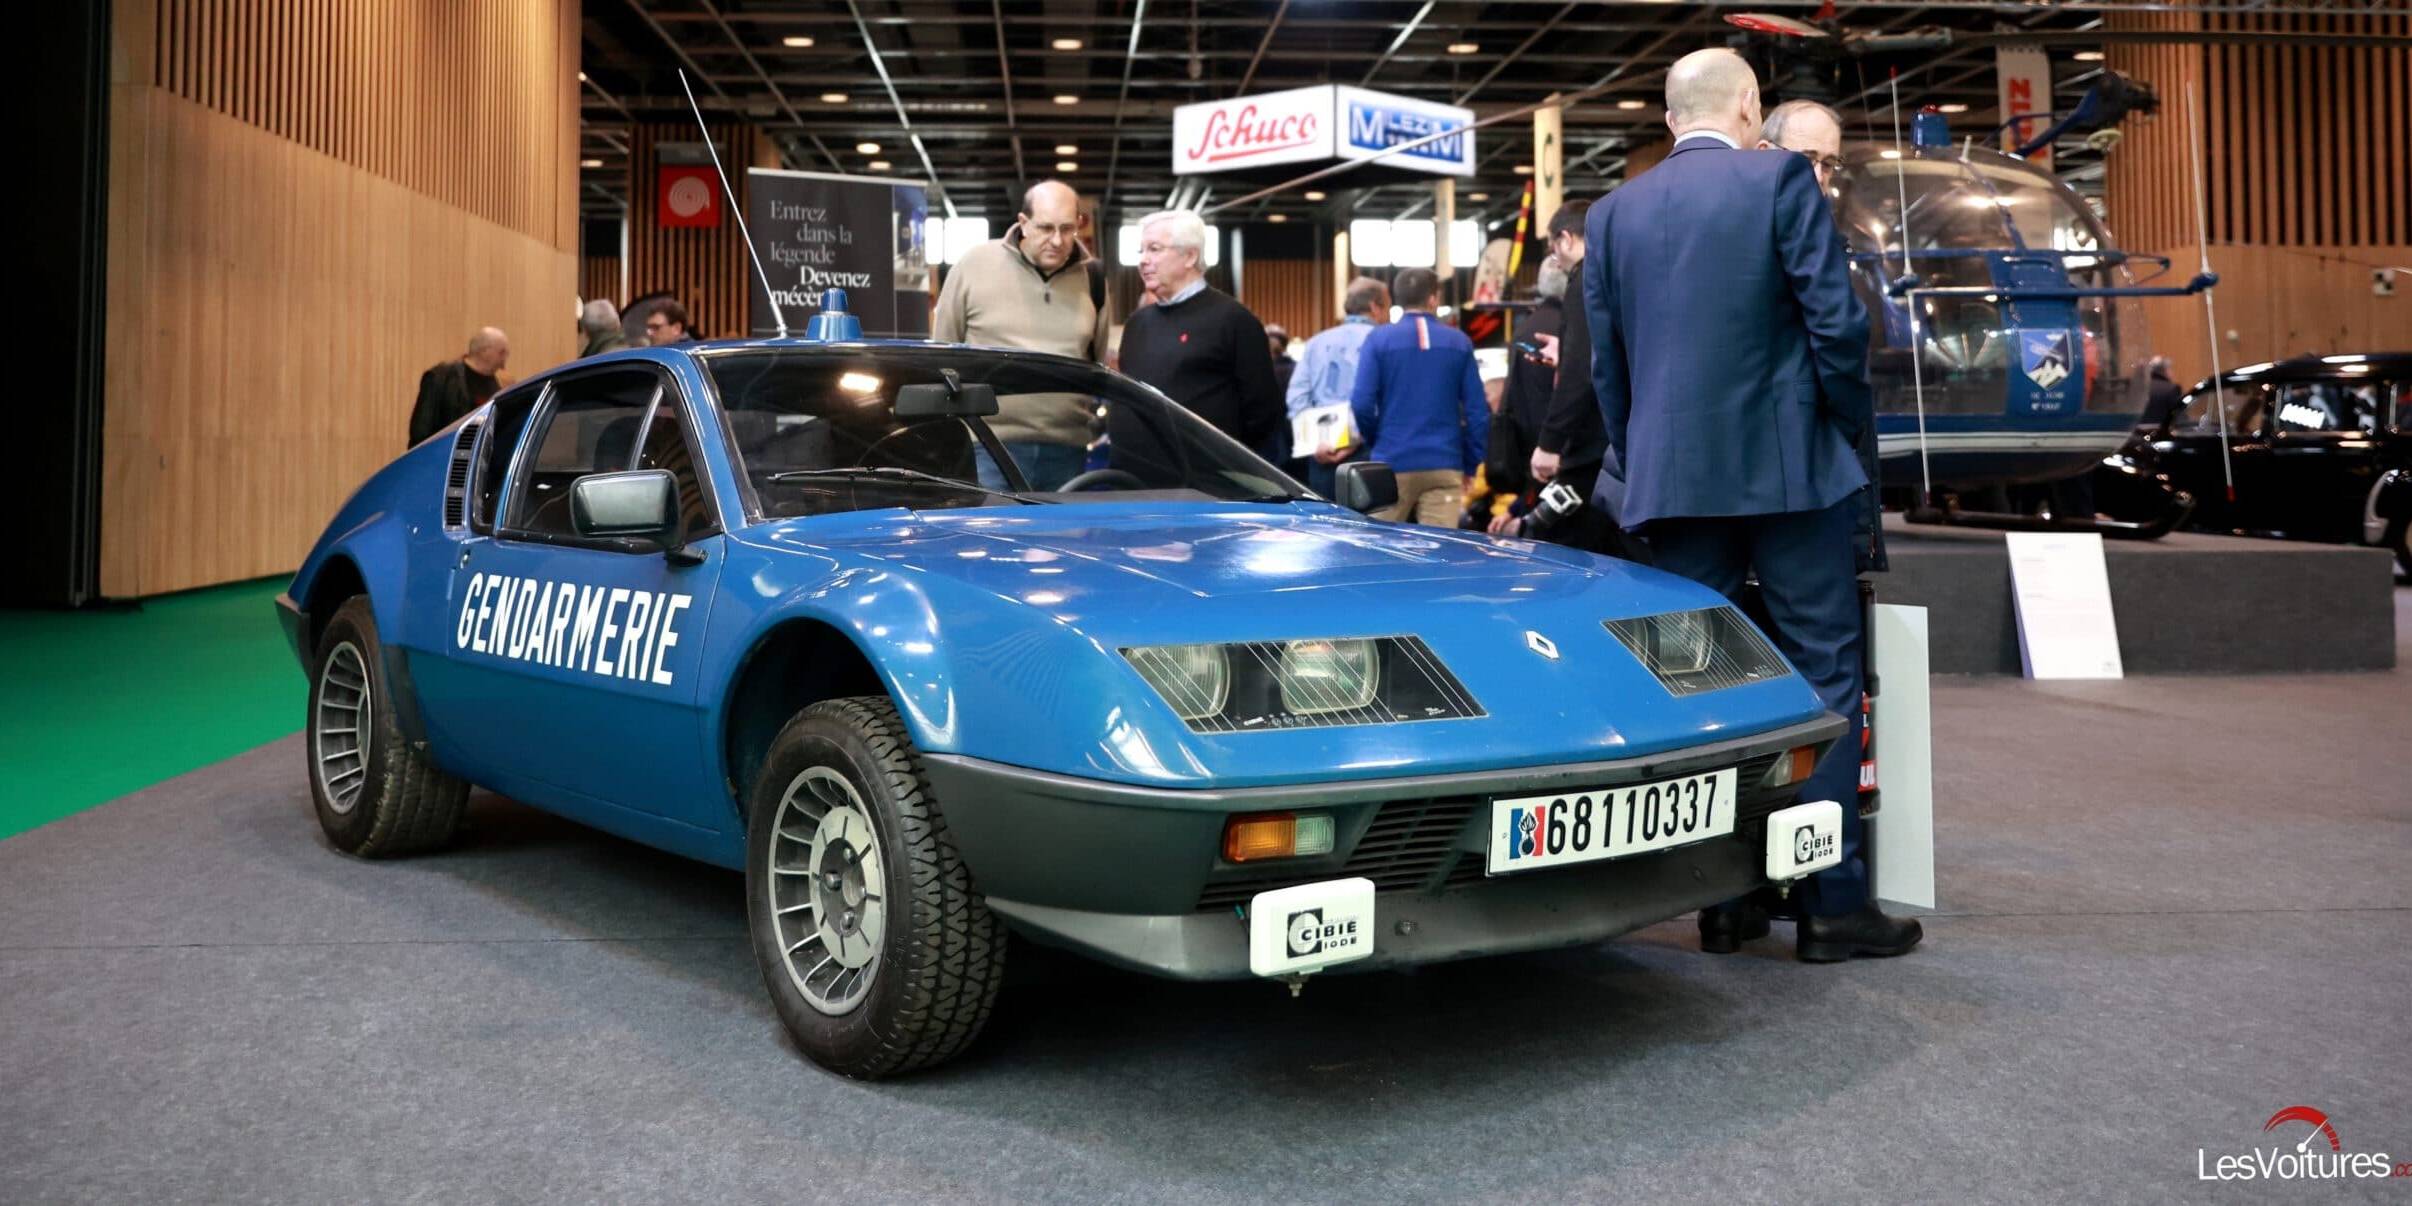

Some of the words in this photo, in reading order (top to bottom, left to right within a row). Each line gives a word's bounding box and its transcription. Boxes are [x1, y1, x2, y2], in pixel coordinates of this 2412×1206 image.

[1188, 105, 1316, 160] Schuco
[770, 200, 827, 222] Entrez
[796, 223, 836, 243] dans
[840, 224, 852, 244] la
[771, 241, 835, 269] légende
[801, 265, 871, 288] Devenez
[457, 572, 692, 686] GENDARMERIE
[1547, 774, 1717, 855] 68110337
[1301, 921, 1357, 941] CIBIE
[1324, 937, 1357, 950] IODE
